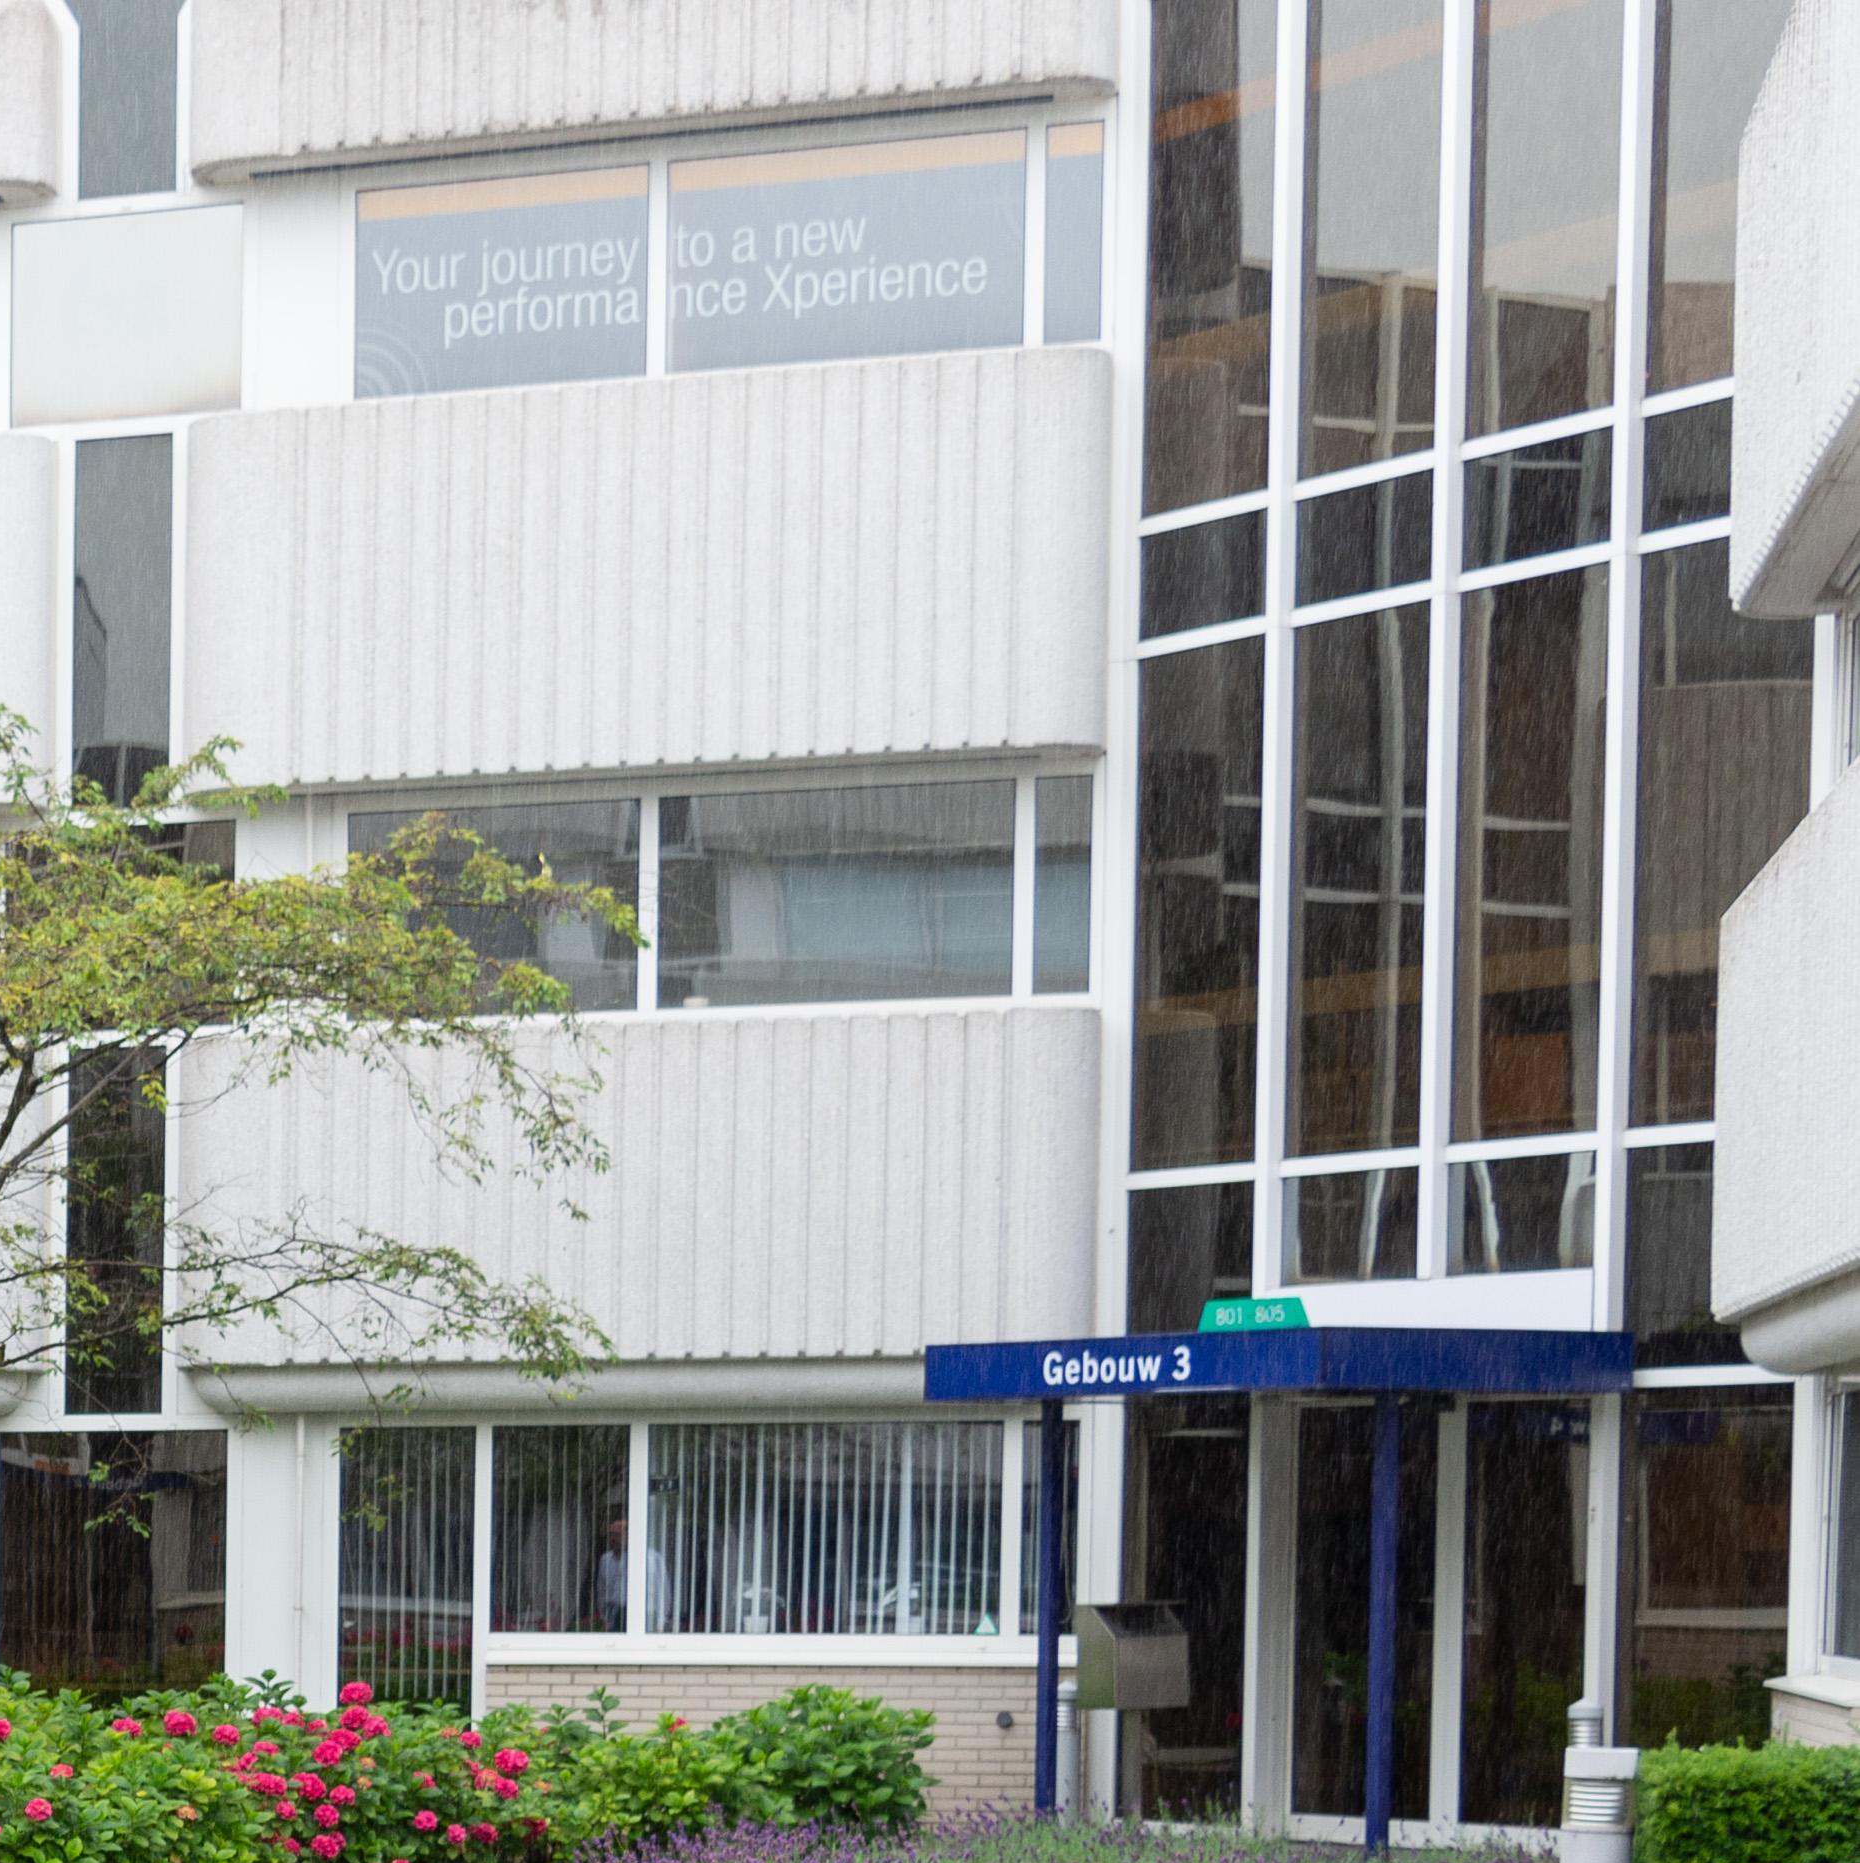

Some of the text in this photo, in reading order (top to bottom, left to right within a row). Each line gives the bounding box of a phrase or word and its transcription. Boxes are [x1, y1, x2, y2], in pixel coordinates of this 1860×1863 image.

[372, 217, 867, 298] Your journey to a new
[762, 254, 989, 320] Xperience
[1042, 1344, 1192, 1386] Gebouw 3
